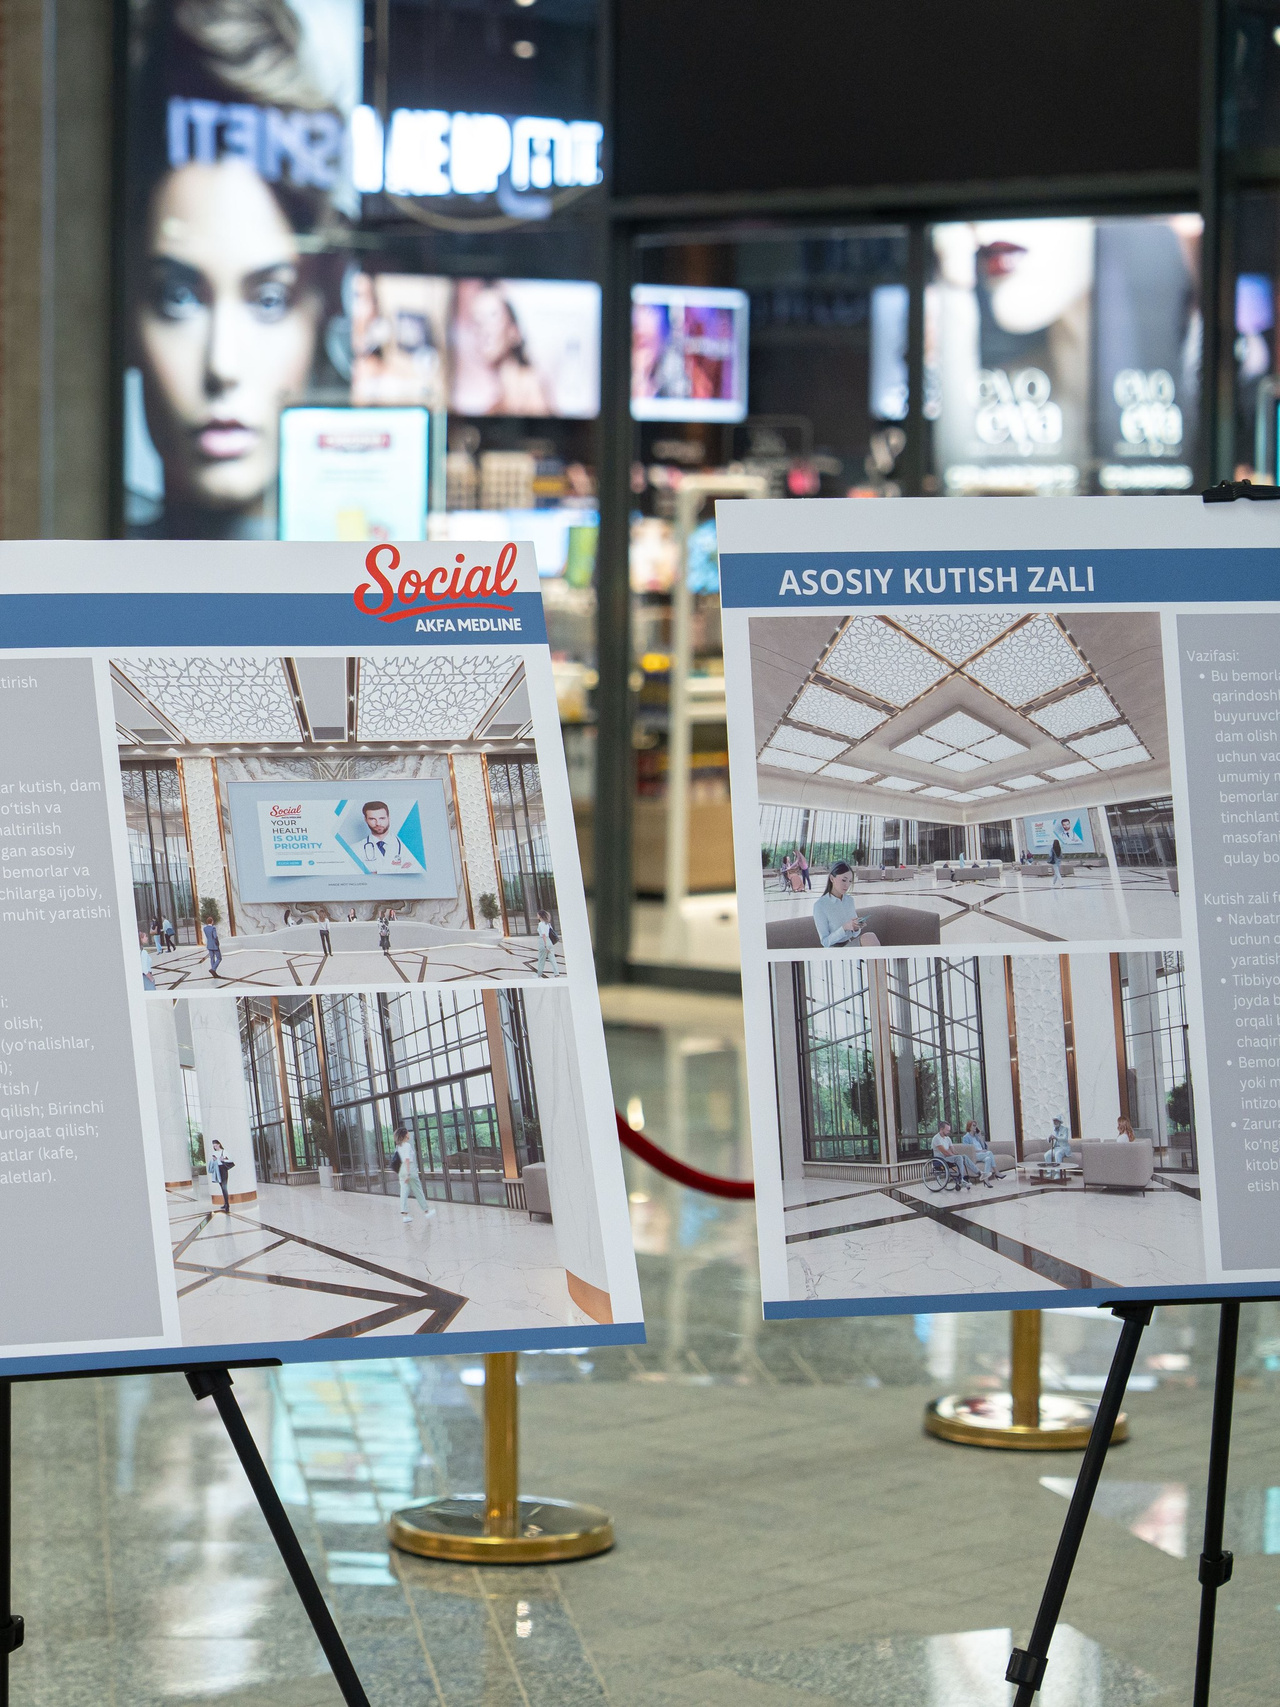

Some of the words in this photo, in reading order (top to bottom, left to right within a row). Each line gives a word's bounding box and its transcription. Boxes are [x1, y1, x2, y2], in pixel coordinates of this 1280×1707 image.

[353, 542, 518, 615] Social
[778, 568, 894, 596] ASOSIY
[904, 567, 1018, 594] KUTISH
[1026, 566, 1095, 592] ZALI
[415, 618, 456, 632] AKFA
[458, 617, 522, 632] MEDLINE
[1187, 649, 1239, 662] Vazifasi:
[1211, 670, 1228, 682] Bu
[1232, 669, 1280, 681] bemorl
[1215, 730, 1243, 742] dam
[1247, 730, 1277, 742] olish
[1217, 751, 1257, 762] uchun
[1218, 770, 1270, 785] umumiy
[19, 780, 66, 794] kutish,
[70, 779, 101, 792] dam
[1220, 790, 1279, 803] bemorlar
[44, 804, 61, 813] va
[270, 805, 301, 817] Social
[31, 843, 75, 858] asosiy
[1224, 852, 1259, 866] qulay
[2, 865, 68, 878] bemorlar
[73, 866, 90, 876] va
[59, 885, 102, 901] ijobiy,
[1204, 892, 1244, 905] Kutish
[1248, 892, 1269, 904] zali
[3, 908, 45, 921] muhit
[49, 906, 110, 923] yaratishi
[1230, 933, 1270, 945] uchun
[1234, 994, 1270, 1010] joyda
[4, 1016, 43, 1030] olish;
[1236, 1014, 1272, 1029] orqali
[1240, 1076, 1266, 1092] yoki
[1, 1104, 44, 1120] qilish;
[49, 1100, 104, 1115] Birinchi
[56, 1123, 99, 1139] qilish;
[1243, 1118, 1280, 1130] Zarur
[38, 1146, 77, 1161] (kafe,
